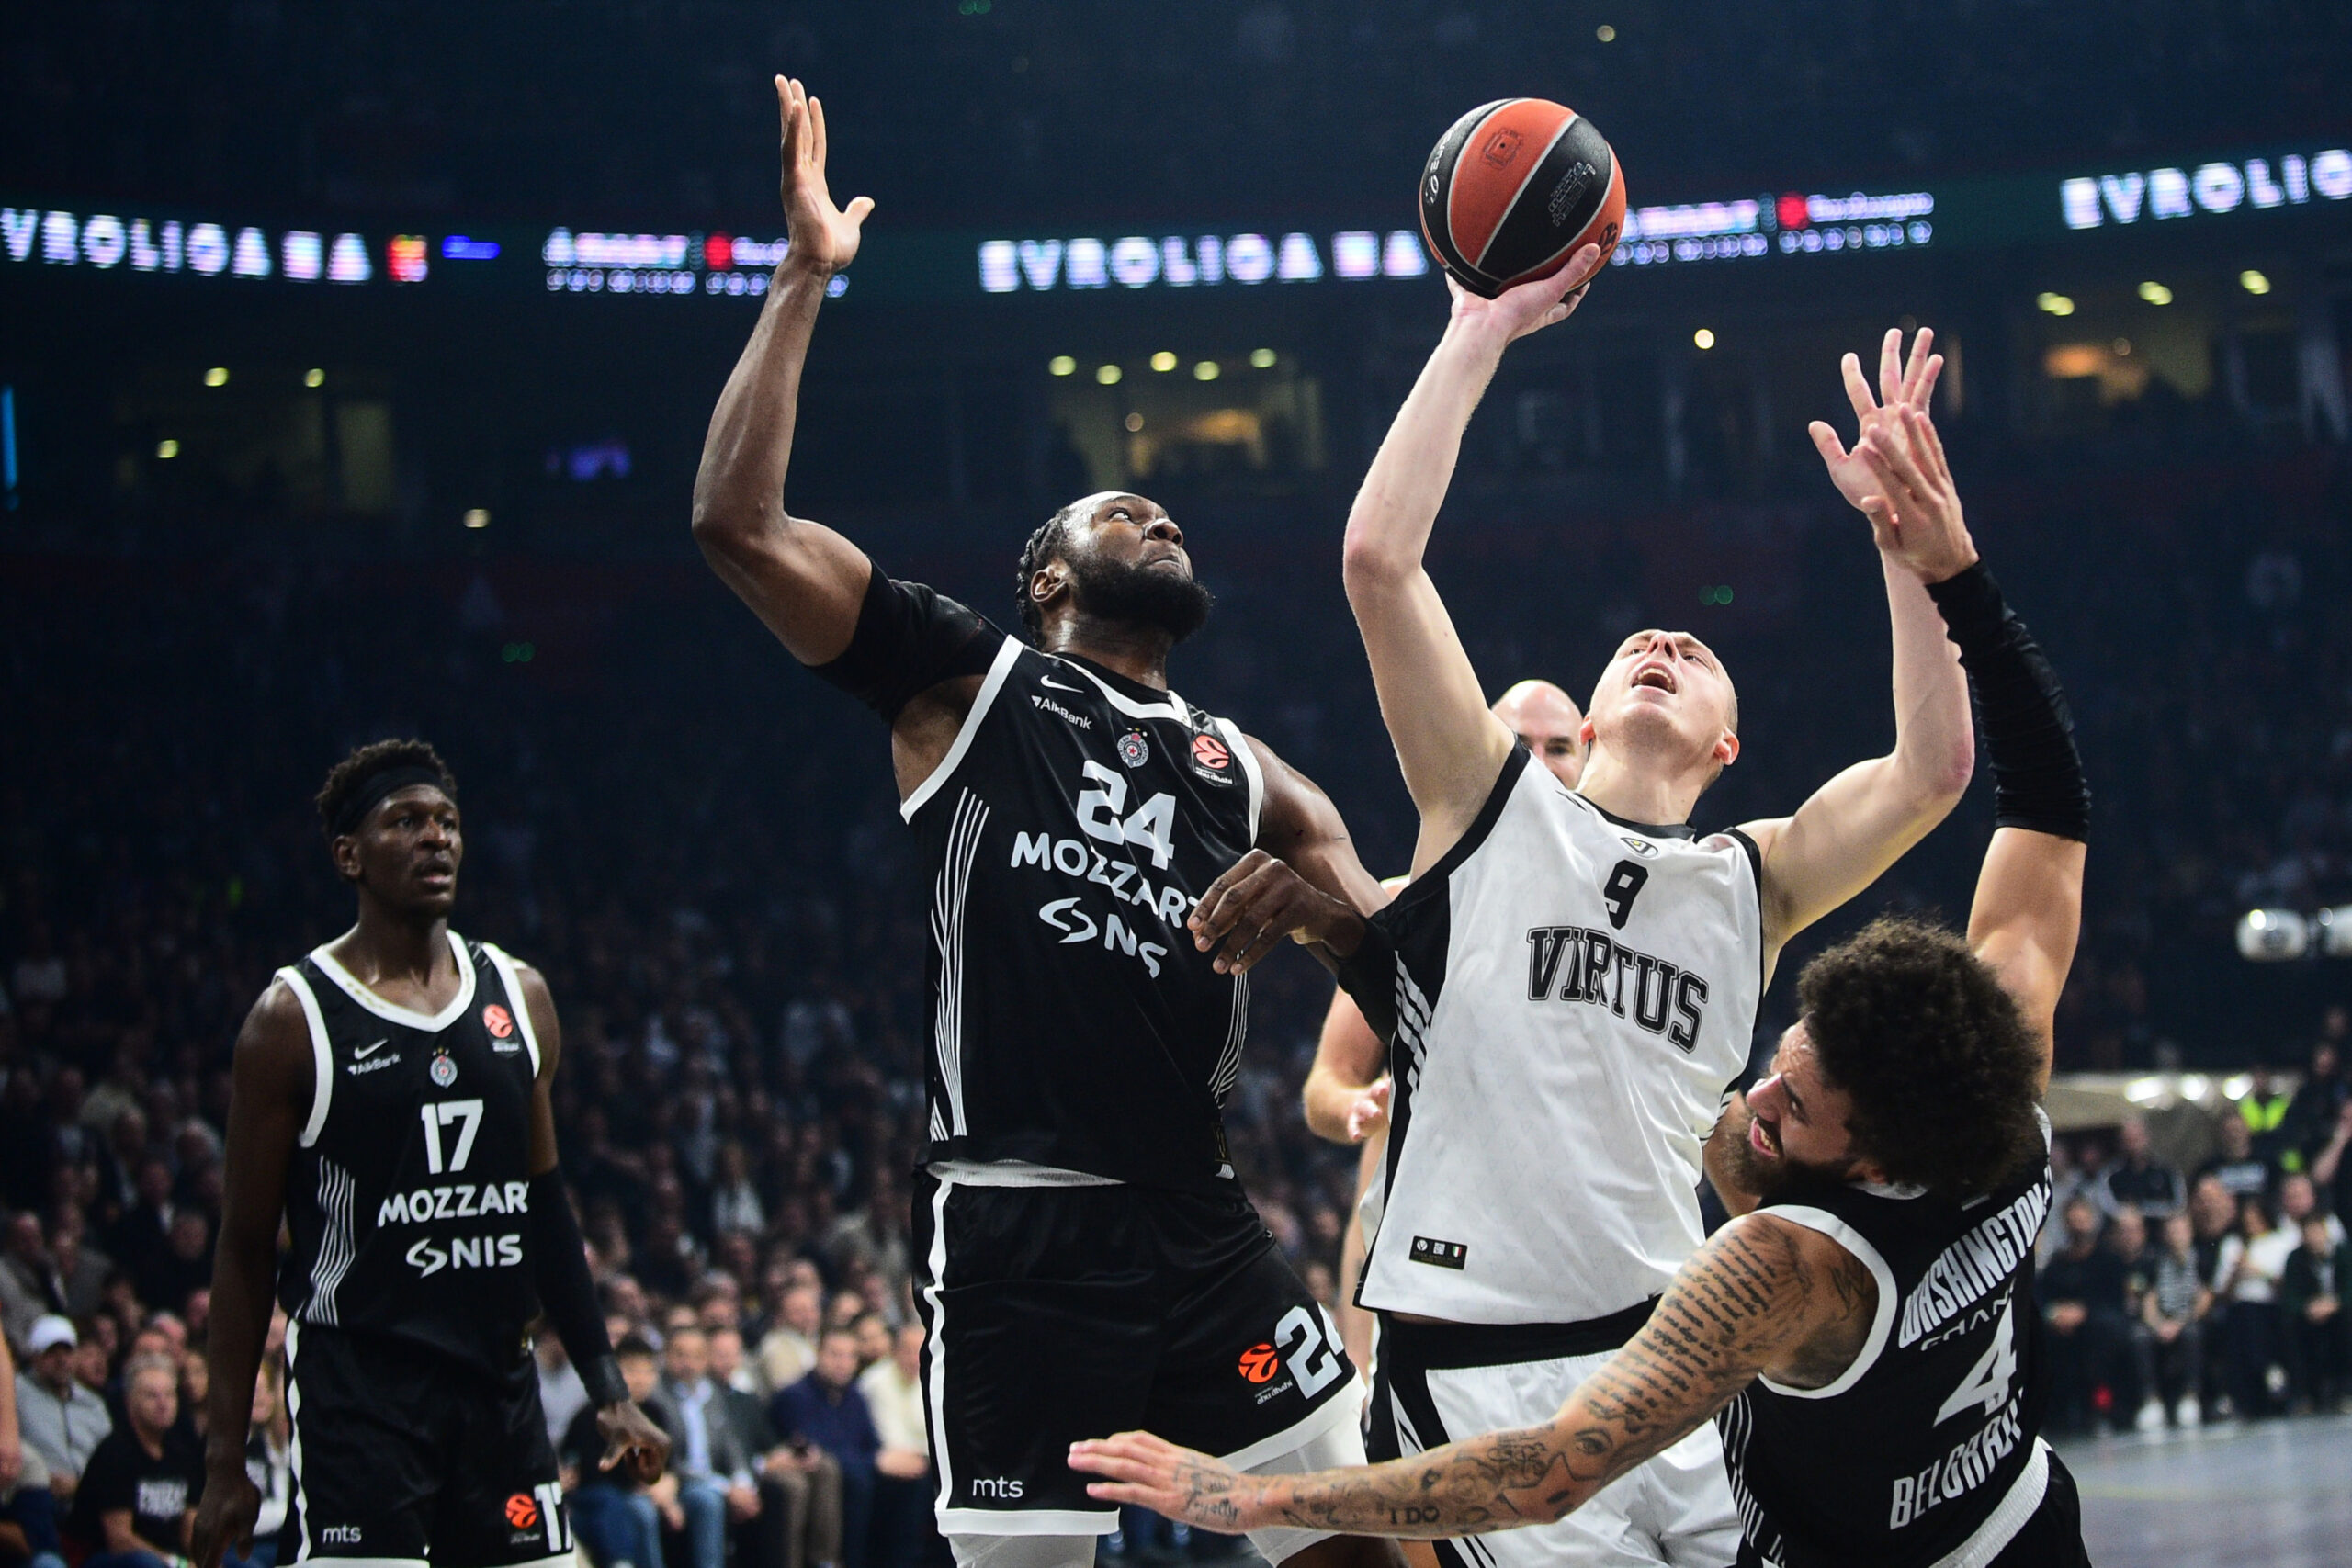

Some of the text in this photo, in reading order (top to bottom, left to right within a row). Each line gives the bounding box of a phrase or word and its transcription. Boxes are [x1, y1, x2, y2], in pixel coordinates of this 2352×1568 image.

[1076, 760, 1176, 871] 24
[1604, 860, 1649, 931] 9
[1526, 926, 1710, 1054] VIRTUS
[421, 1099, 484, 1175] 17
[452, 1234, 523, 1269] NIS
[1933, 1297, 2017, 1428] 4
[972, 1475, 1023, 1499] mts
[322, 1522, 362, 1545] mts
